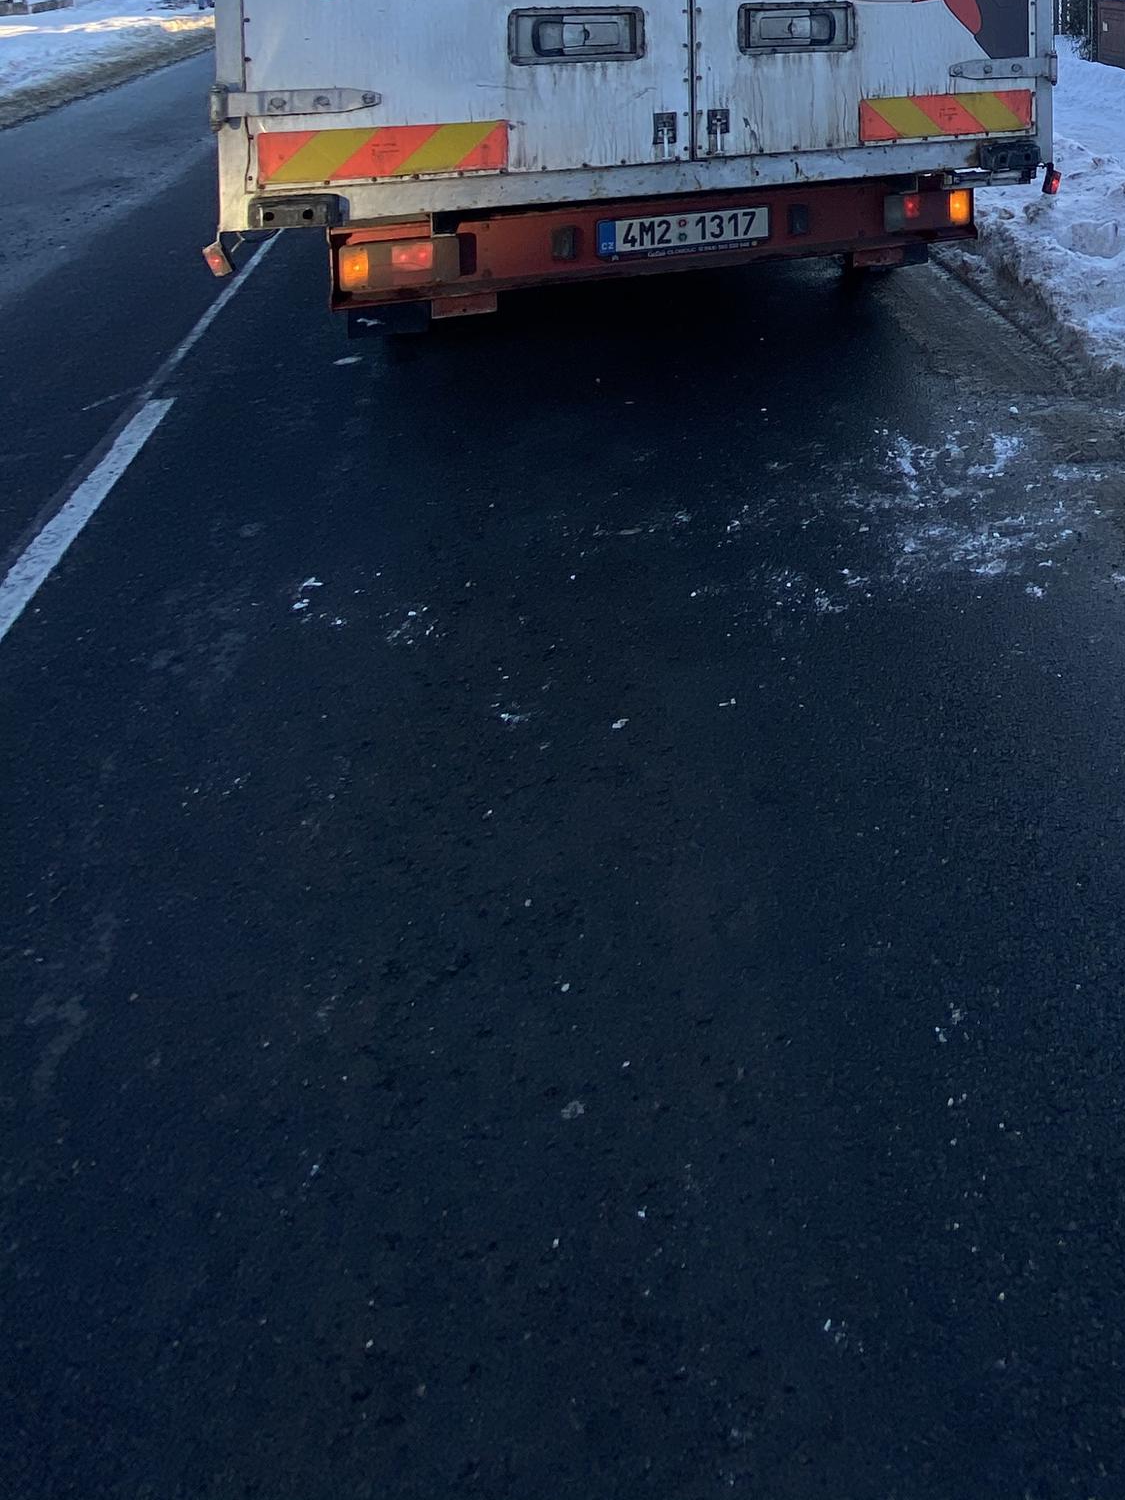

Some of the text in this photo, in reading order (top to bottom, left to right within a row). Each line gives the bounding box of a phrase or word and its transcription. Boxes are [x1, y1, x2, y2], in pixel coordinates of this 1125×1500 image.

[601, 211, 757, 251] CZ 4M2 1317
